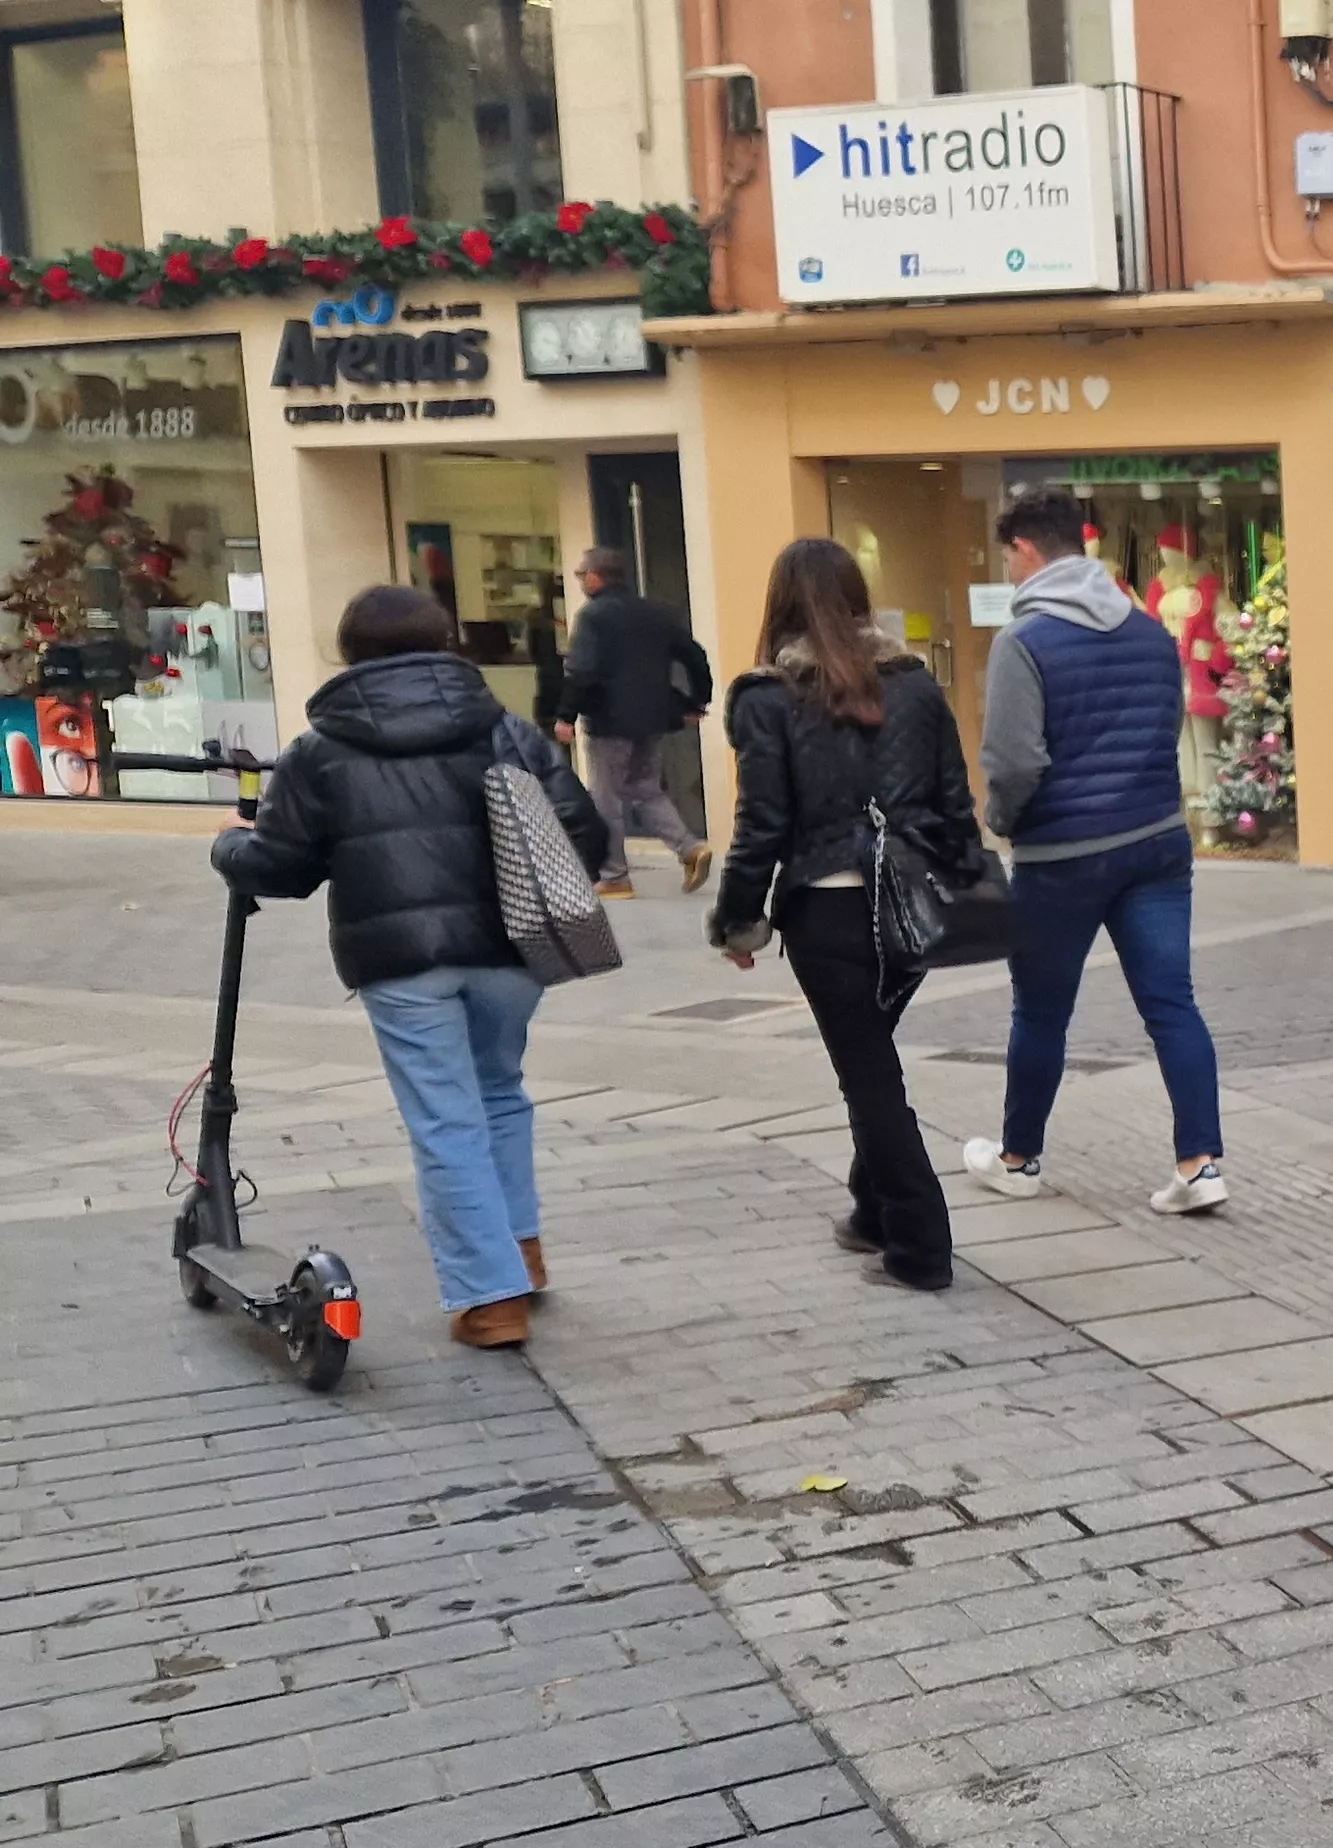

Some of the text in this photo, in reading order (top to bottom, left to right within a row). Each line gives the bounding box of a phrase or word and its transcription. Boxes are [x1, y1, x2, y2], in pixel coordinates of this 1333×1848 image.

[839, 109, 1066, 179] hitradio
[841, 181, 1070, 217] Huesca 107.1fm
[271, 320, 489, 392] Arenas
[975, 376, 1071, 416] JCN
[136, 406, 195, 439] 1888
